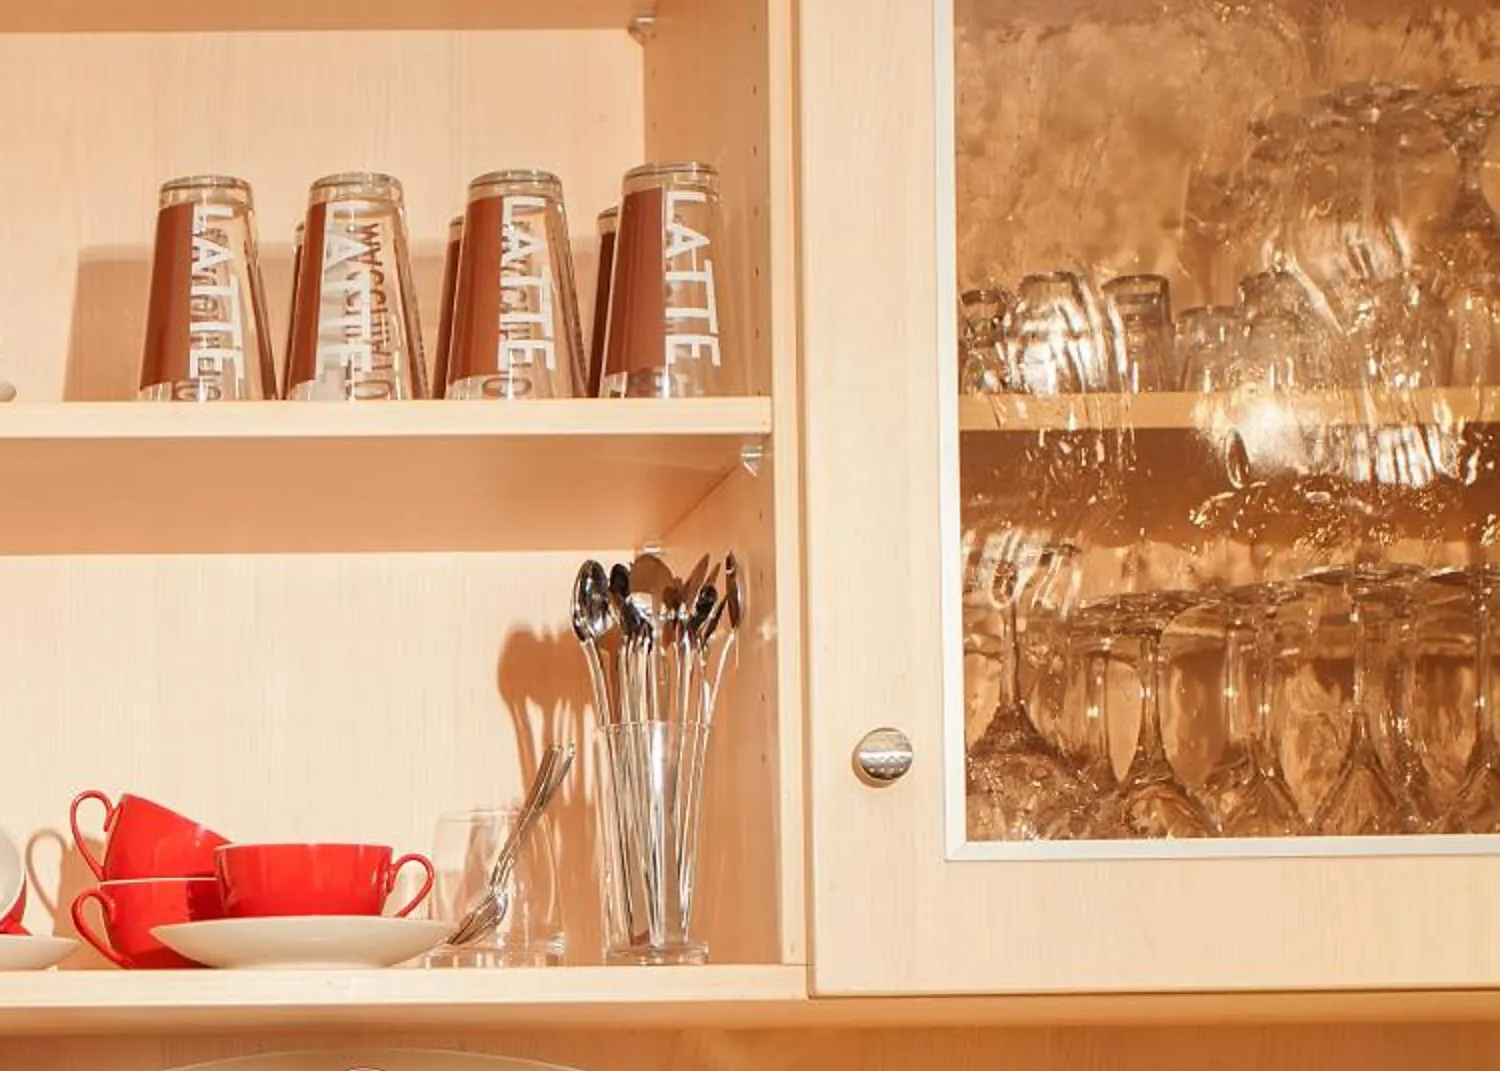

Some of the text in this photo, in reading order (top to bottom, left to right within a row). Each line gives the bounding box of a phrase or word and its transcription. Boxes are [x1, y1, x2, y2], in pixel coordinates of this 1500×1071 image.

[190, 204, 245, 380] LATTE
[316, 201, 376, 378] LATTE
[498, 196, 556, 370] LATTE
[665, 191, 721, 366] LATTE
